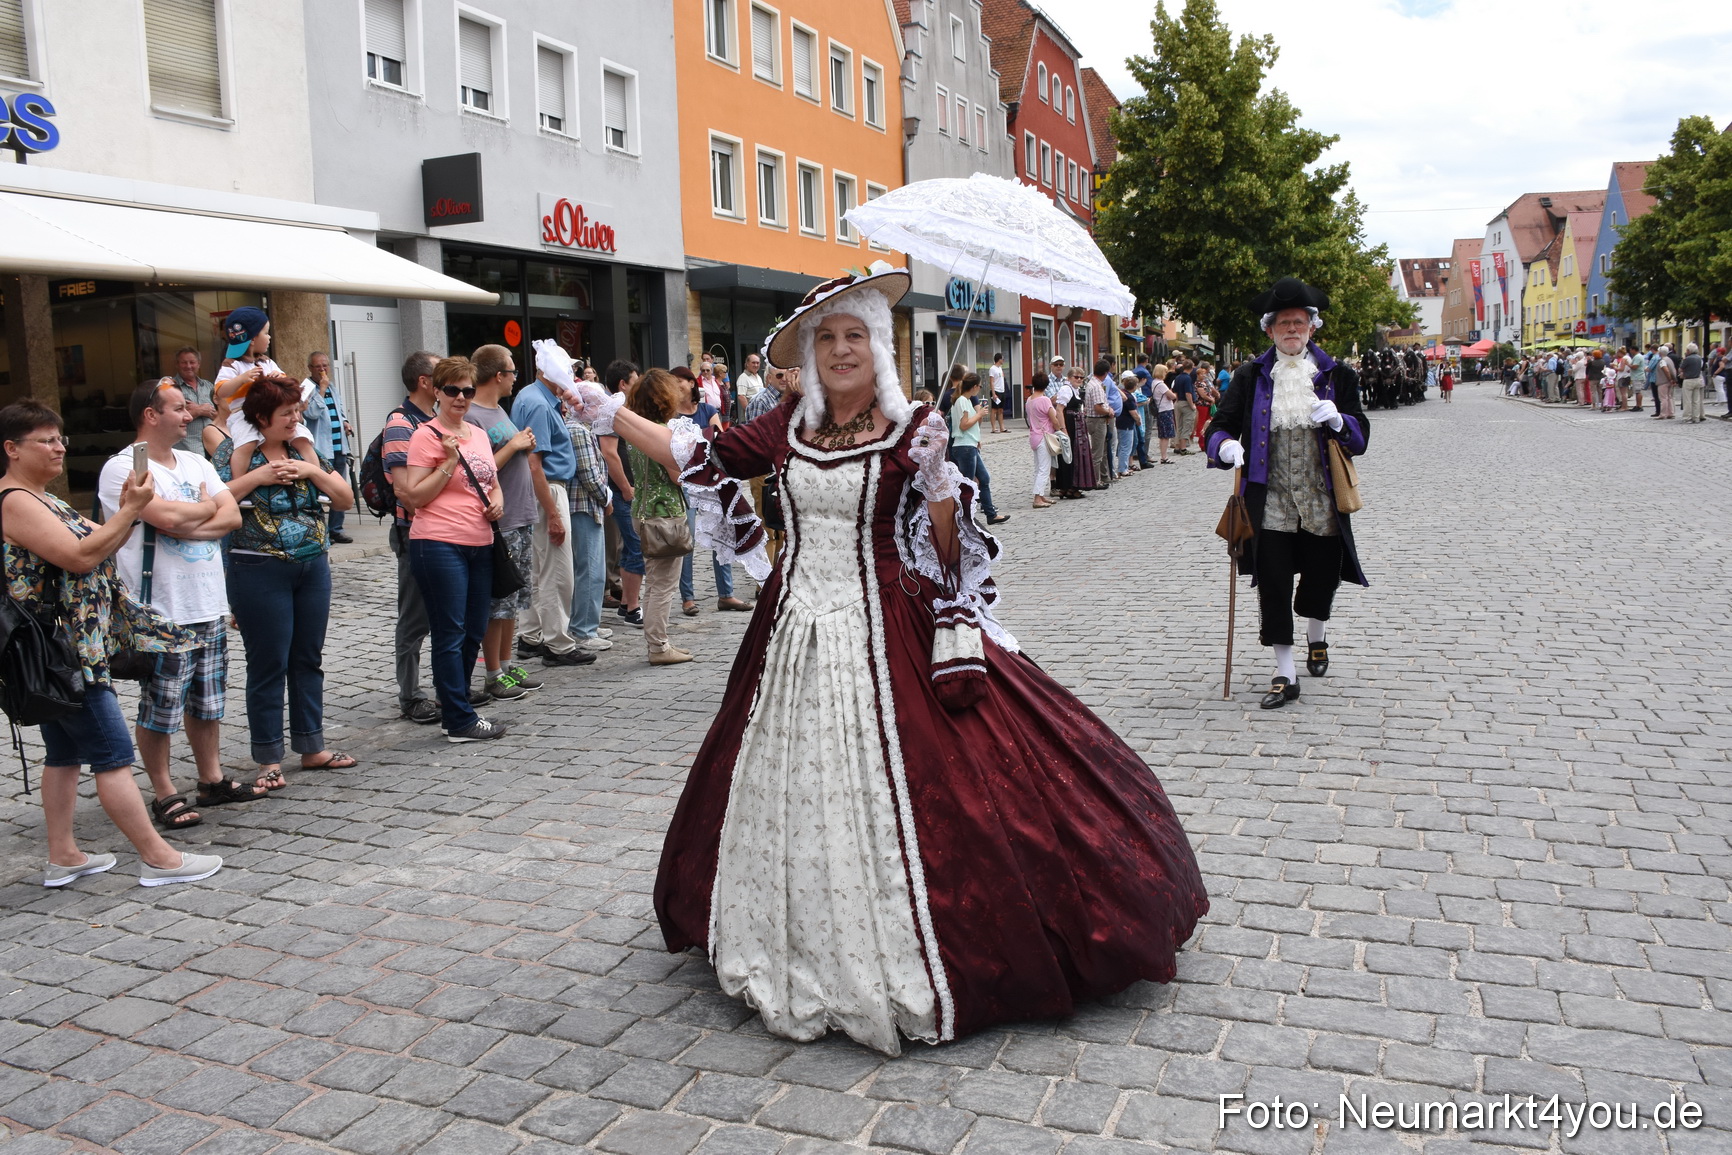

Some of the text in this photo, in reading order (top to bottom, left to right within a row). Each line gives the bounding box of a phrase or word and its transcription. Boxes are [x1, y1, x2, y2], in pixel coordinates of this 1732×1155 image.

[431, 197, 472, 217] s.Oliver
[543, 198, 617, 253] s.Oliver
[59, 281, 96, 298] FRIES
